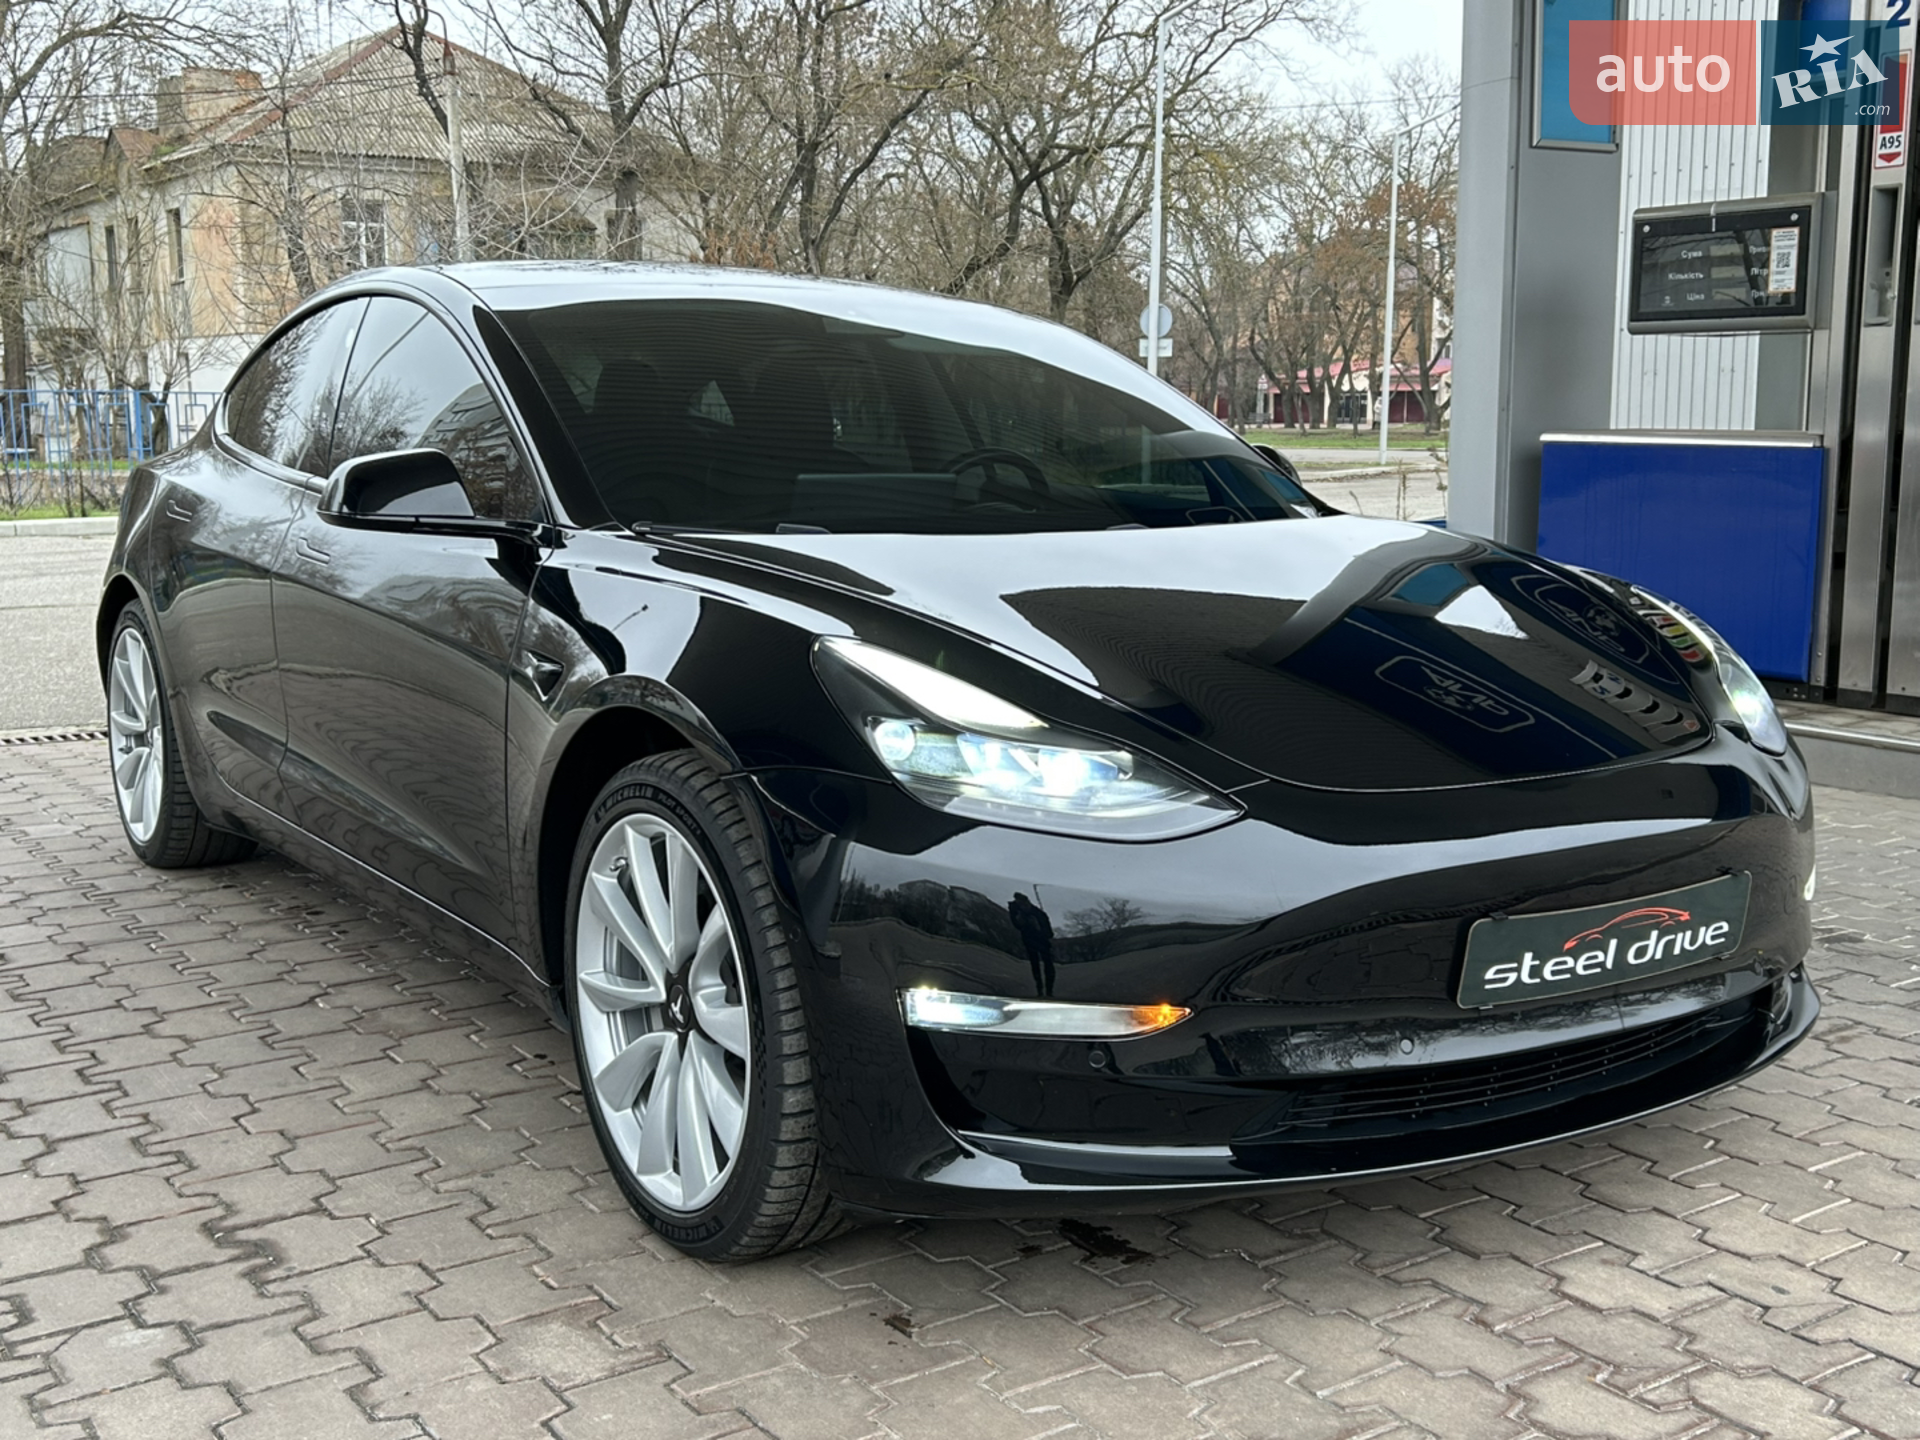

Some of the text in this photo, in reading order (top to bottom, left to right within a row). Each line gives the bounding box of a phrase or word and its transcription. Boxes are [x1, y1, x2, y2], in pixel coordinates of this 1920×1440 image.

[1885, 0, 1912, 29] 2
[1681, 250, 1703, 260] Сума
[606, 785, 655, 809] MICHELIN
[1484, 920, 1730, 989] steel drive
[653, 1218, 708, 1241] MICHELIN
